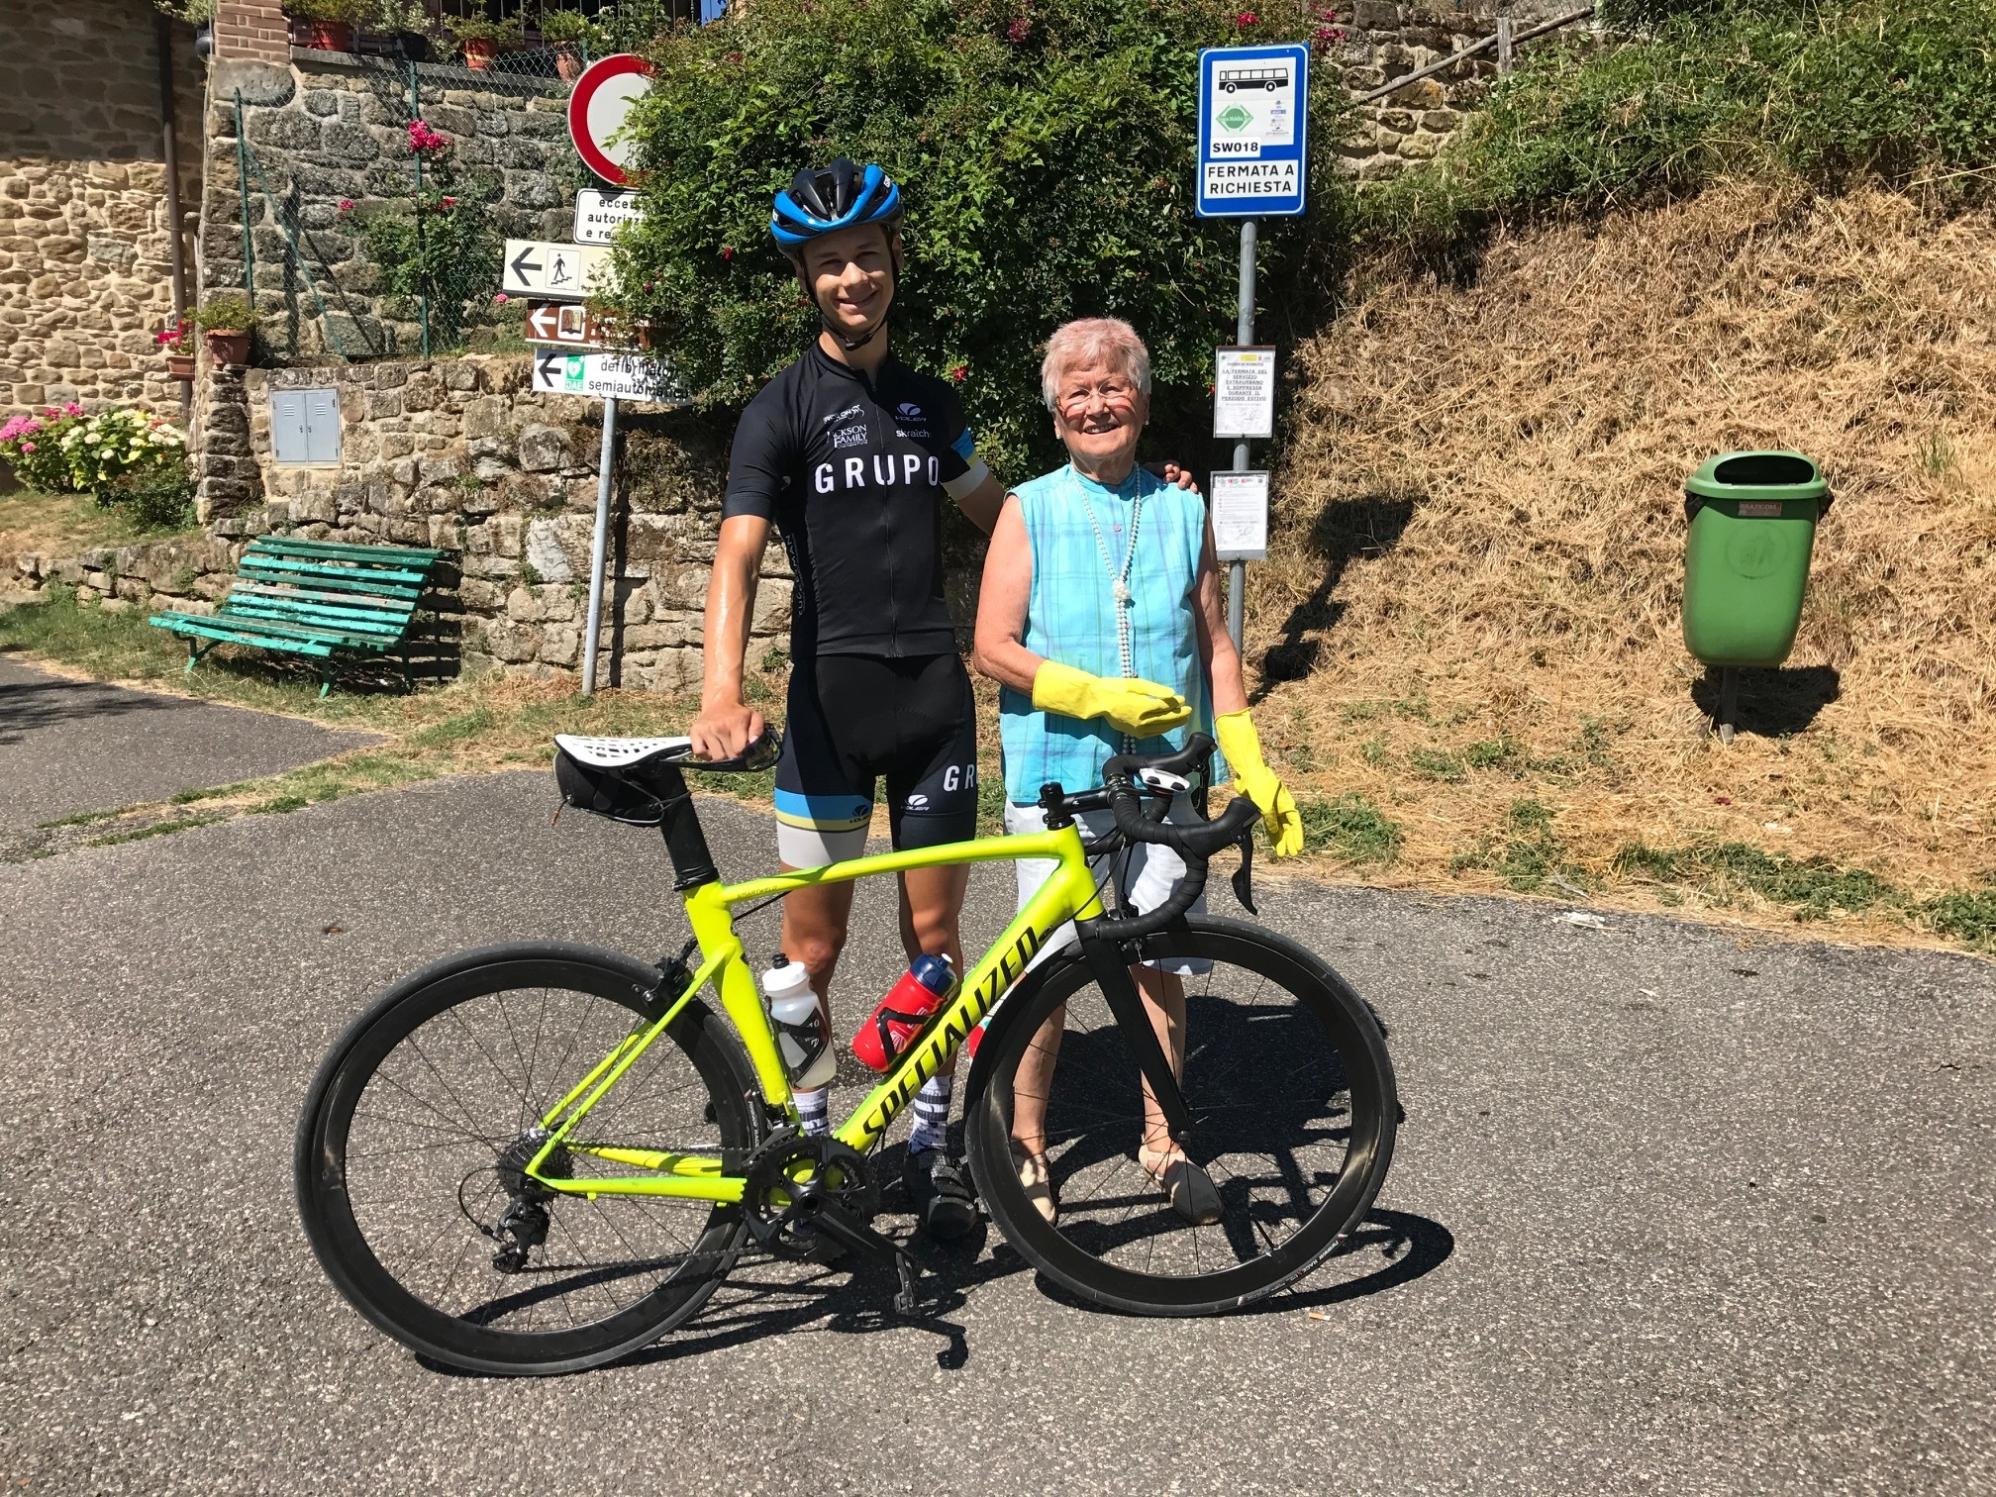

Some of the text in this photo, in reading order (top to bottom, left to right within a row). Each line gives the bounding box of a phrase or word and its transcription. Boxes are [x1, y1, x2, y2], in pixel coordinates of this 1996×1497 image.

[1212, 141, 1259, 153] SW018
[1208, 163, 1295, 178] FERMATA A
[1209, 180, 1292, 194] RICHIESTA
[587, 213, 641, 225] autorizz
[833, 432, 868, 448] FAMILY
[895, 428, 930, 438] skratch
[814, 454, 939, 494] GRUPO
[862, 925, 1040, 1136] SPECIALIZED
